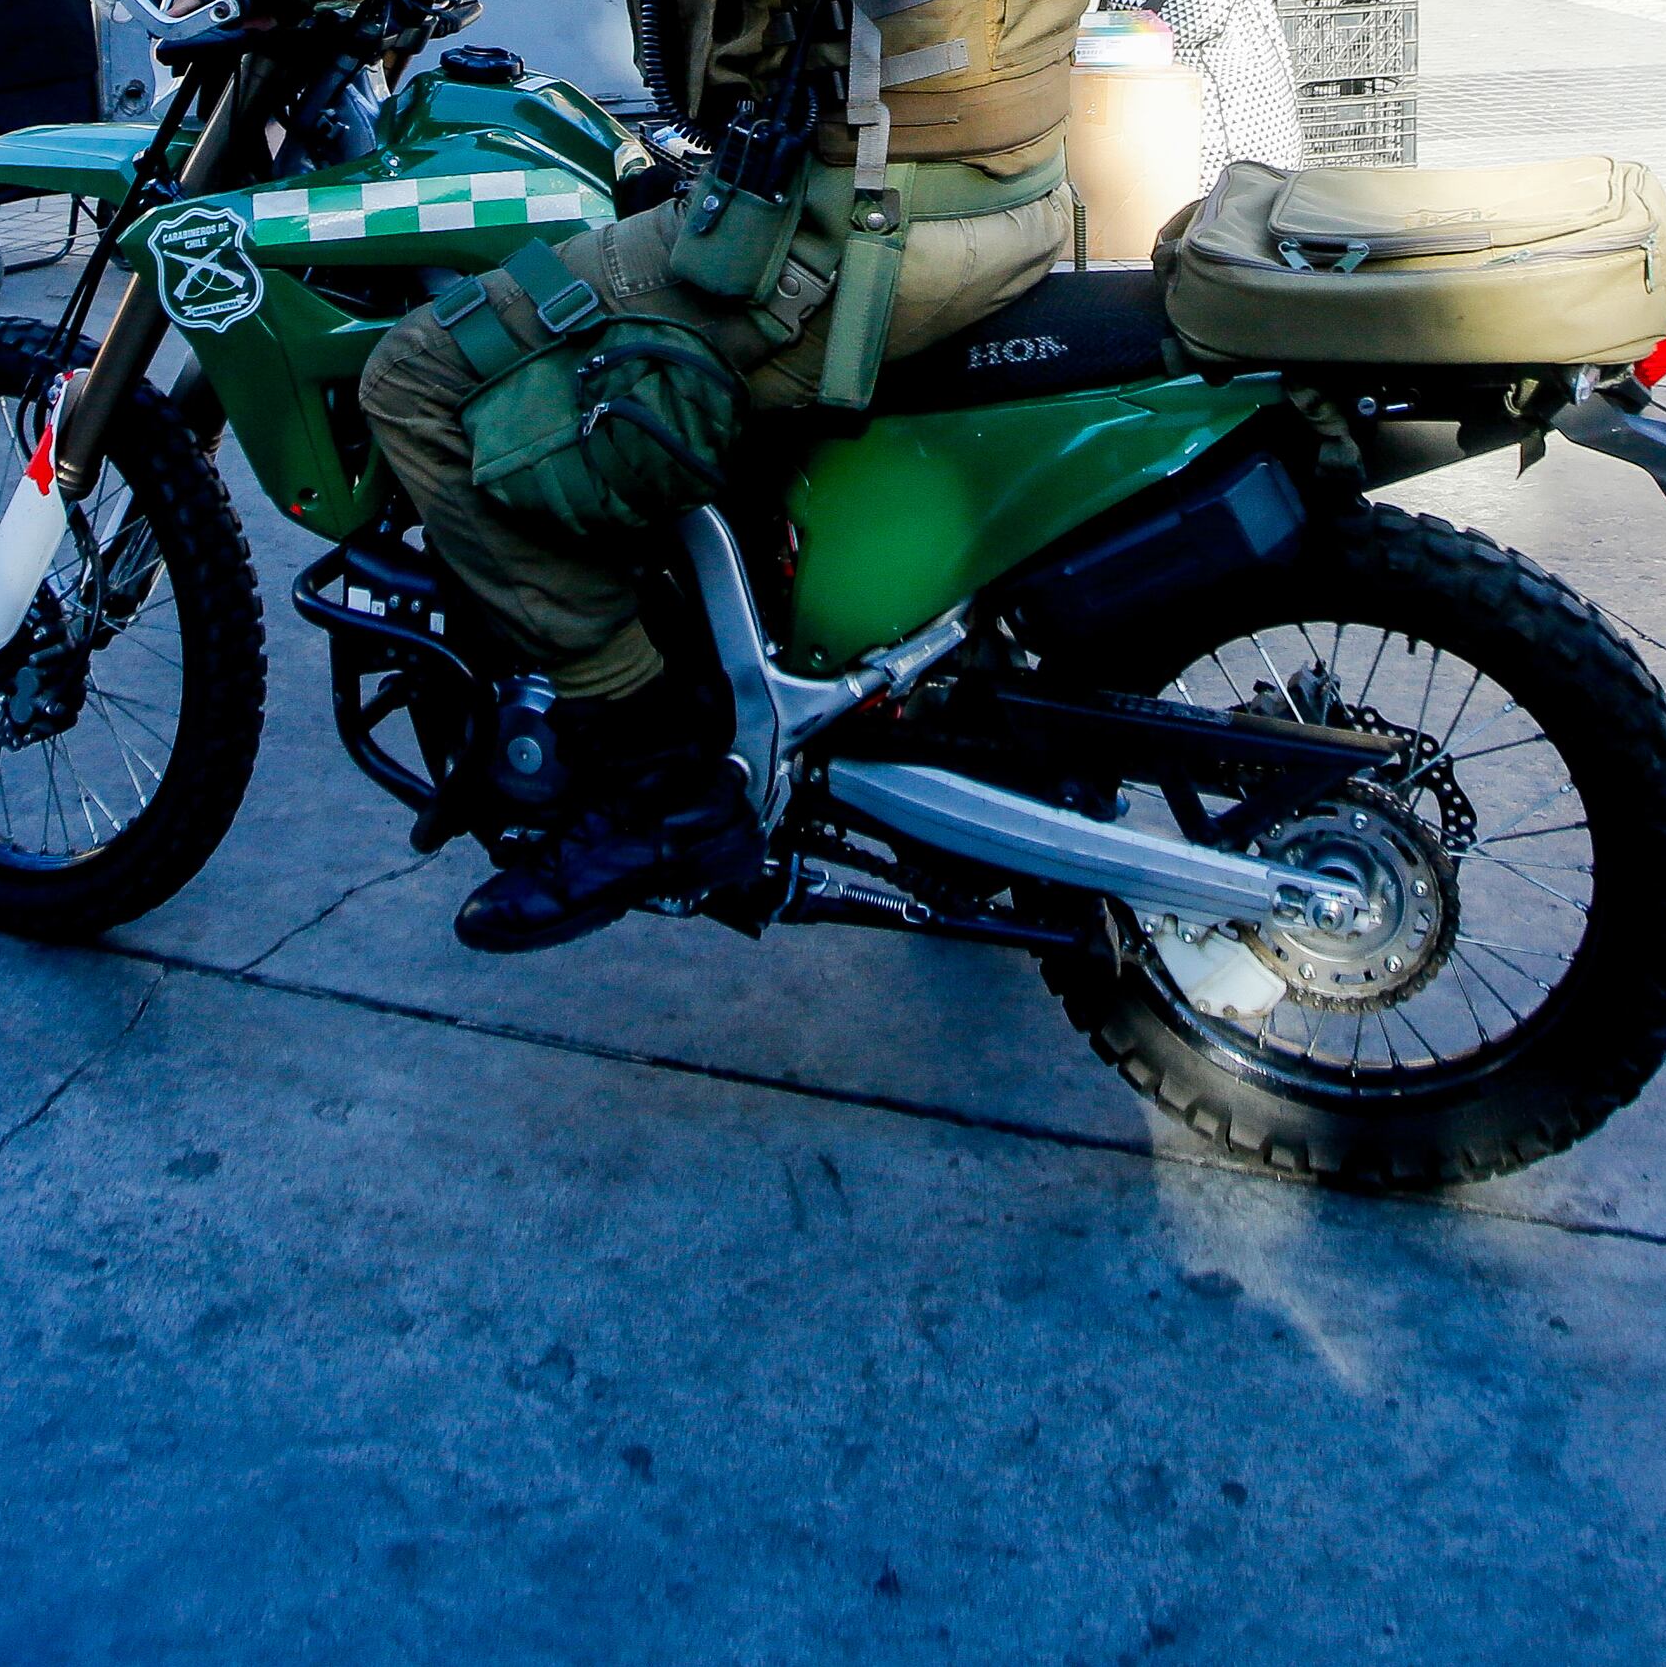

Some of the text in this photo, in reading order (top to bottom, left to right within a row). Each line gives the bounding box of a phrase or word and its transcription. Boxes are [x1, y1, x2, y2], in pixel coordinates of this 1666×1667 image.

[162, 222, 230, 244] CARABINEROS DE
[185, 237, 207, 249] CHILE
